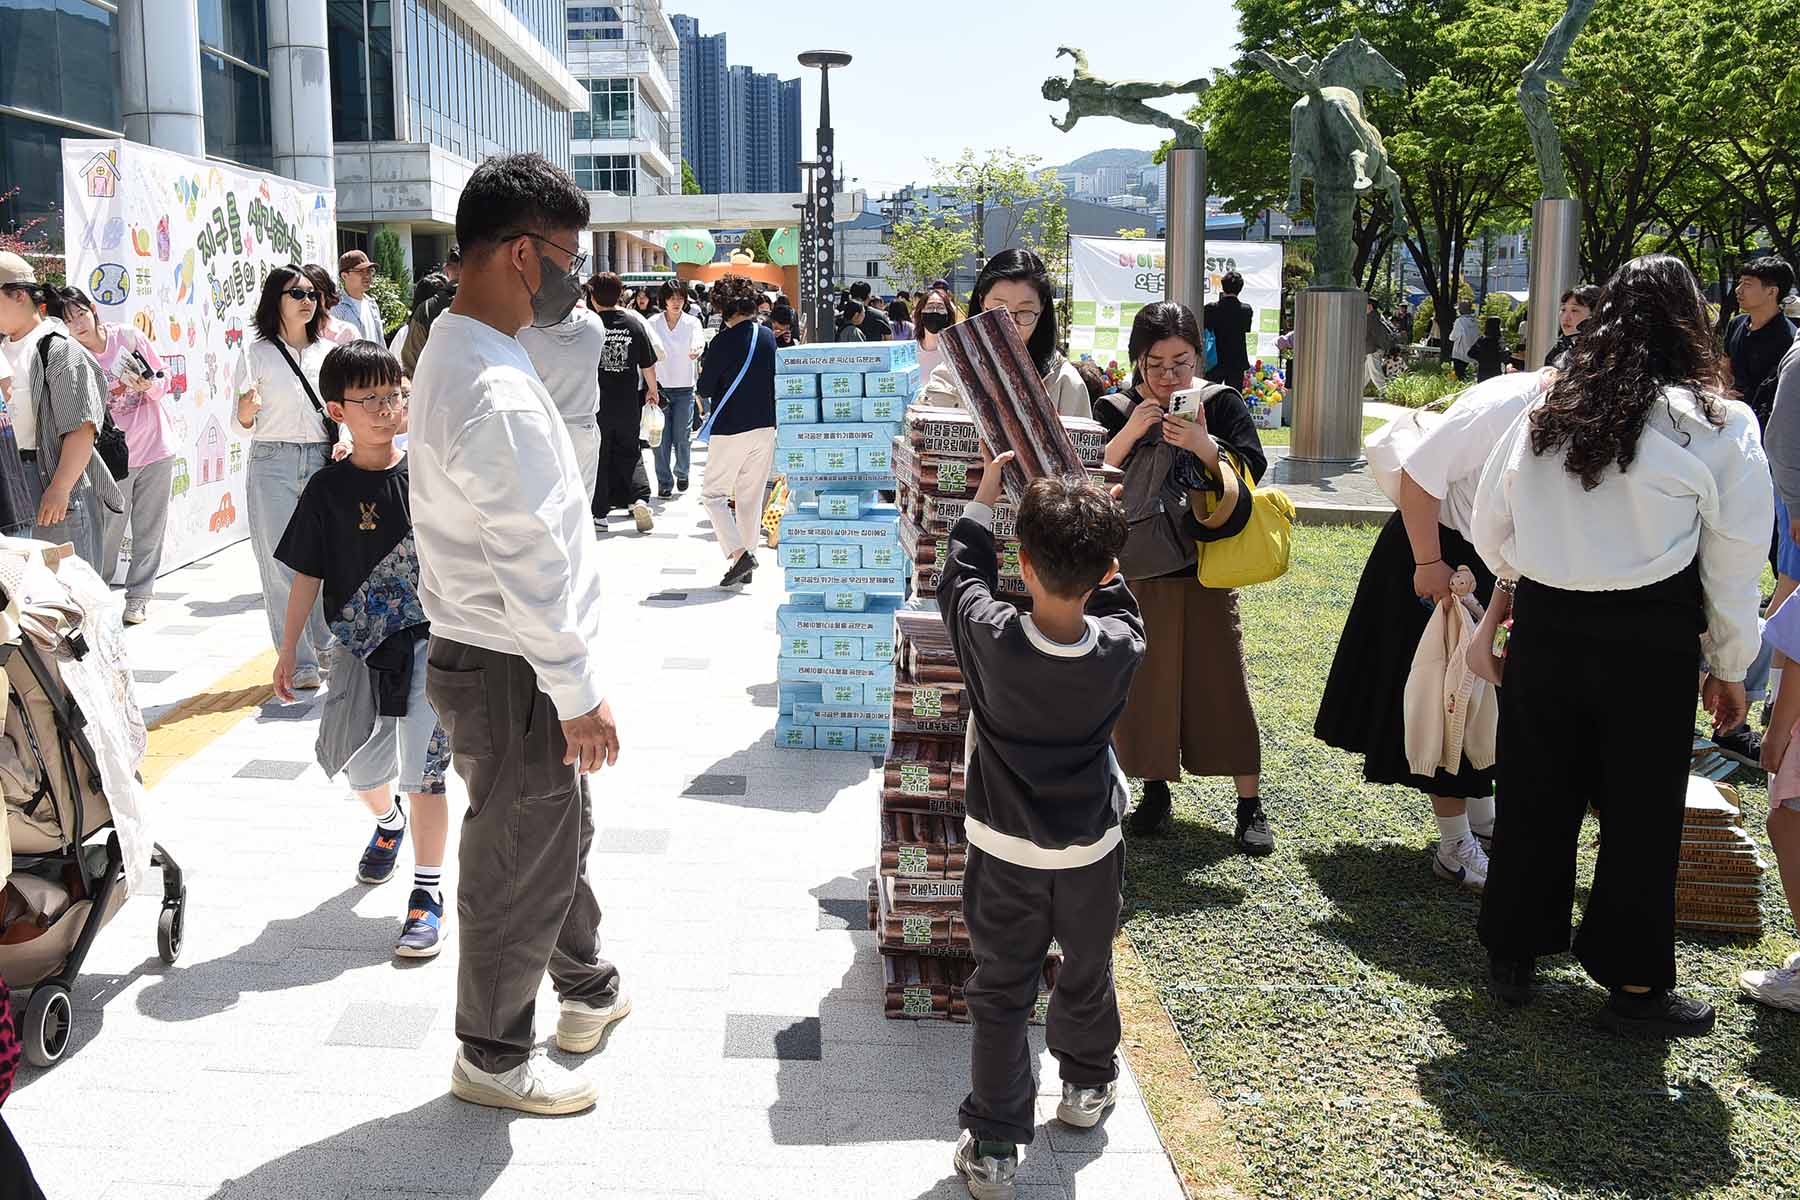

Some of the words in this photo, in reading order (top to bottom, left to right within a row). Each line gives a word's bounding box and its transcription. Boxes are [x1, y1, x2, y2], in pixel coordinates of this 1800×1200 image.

[197, 191, 242, 266] 지구를
[1206, 256, 1236, 271] STA
[924, 424, 959, 438] 사람들은
[925, 438, 968, 453] 열대우림에
[1082, 433, 1100, 446] 위해
[911, 883, 928, 896] 해요
